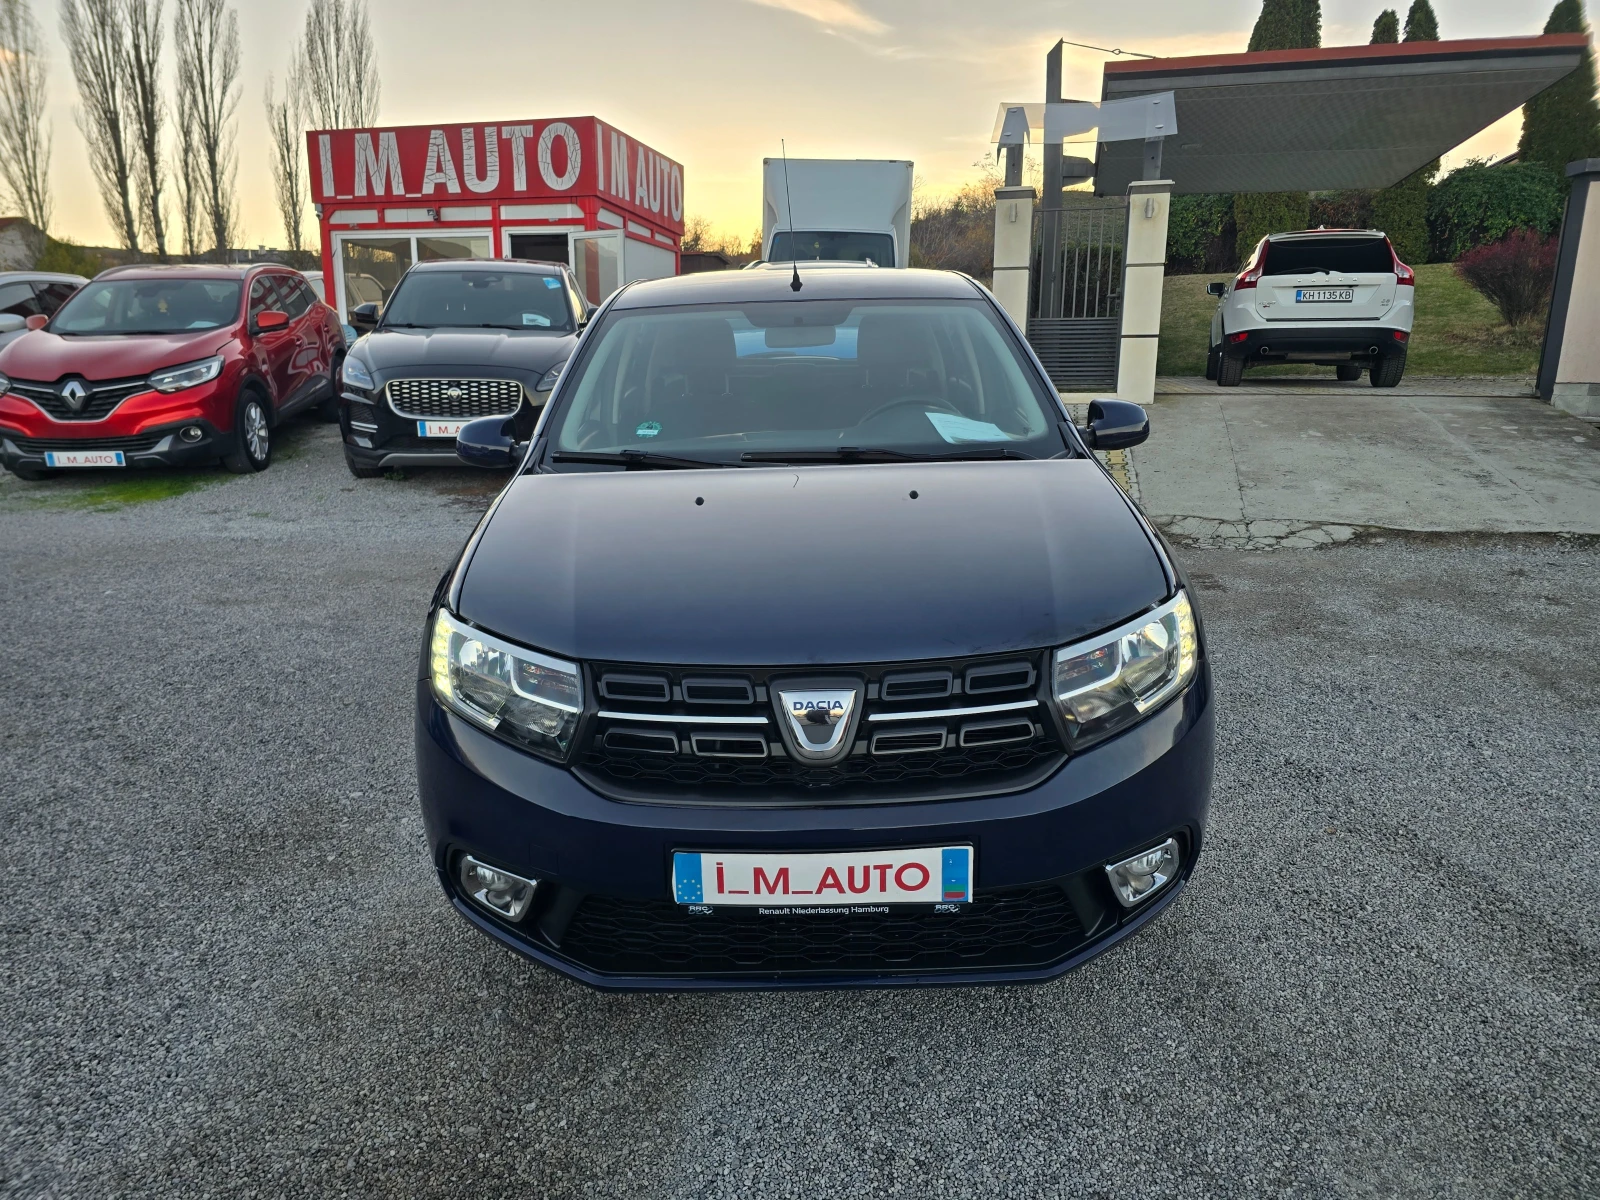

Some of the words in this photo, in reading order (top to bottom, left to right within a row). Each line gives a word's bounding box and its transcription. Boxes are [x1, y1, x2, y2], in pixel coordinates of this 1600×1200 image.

[318, 122, 581, 198] I_M_AUTO
[597, 123, 604, 191] I
[611, 131, 630, 201] M
[635, 145, 682, 222] AUTO
[1302, 291, 1315, 300] KH
[1317, 291, 1338, 300] 1135
[1339, 291, 1351, 300] KB
[793, 701, 843, 710] DACIA
[758, 907, 790, 915] Renault
[792, 907, 849, 915] Niederlassung
[851, 906, 889, 914] Hamburg
